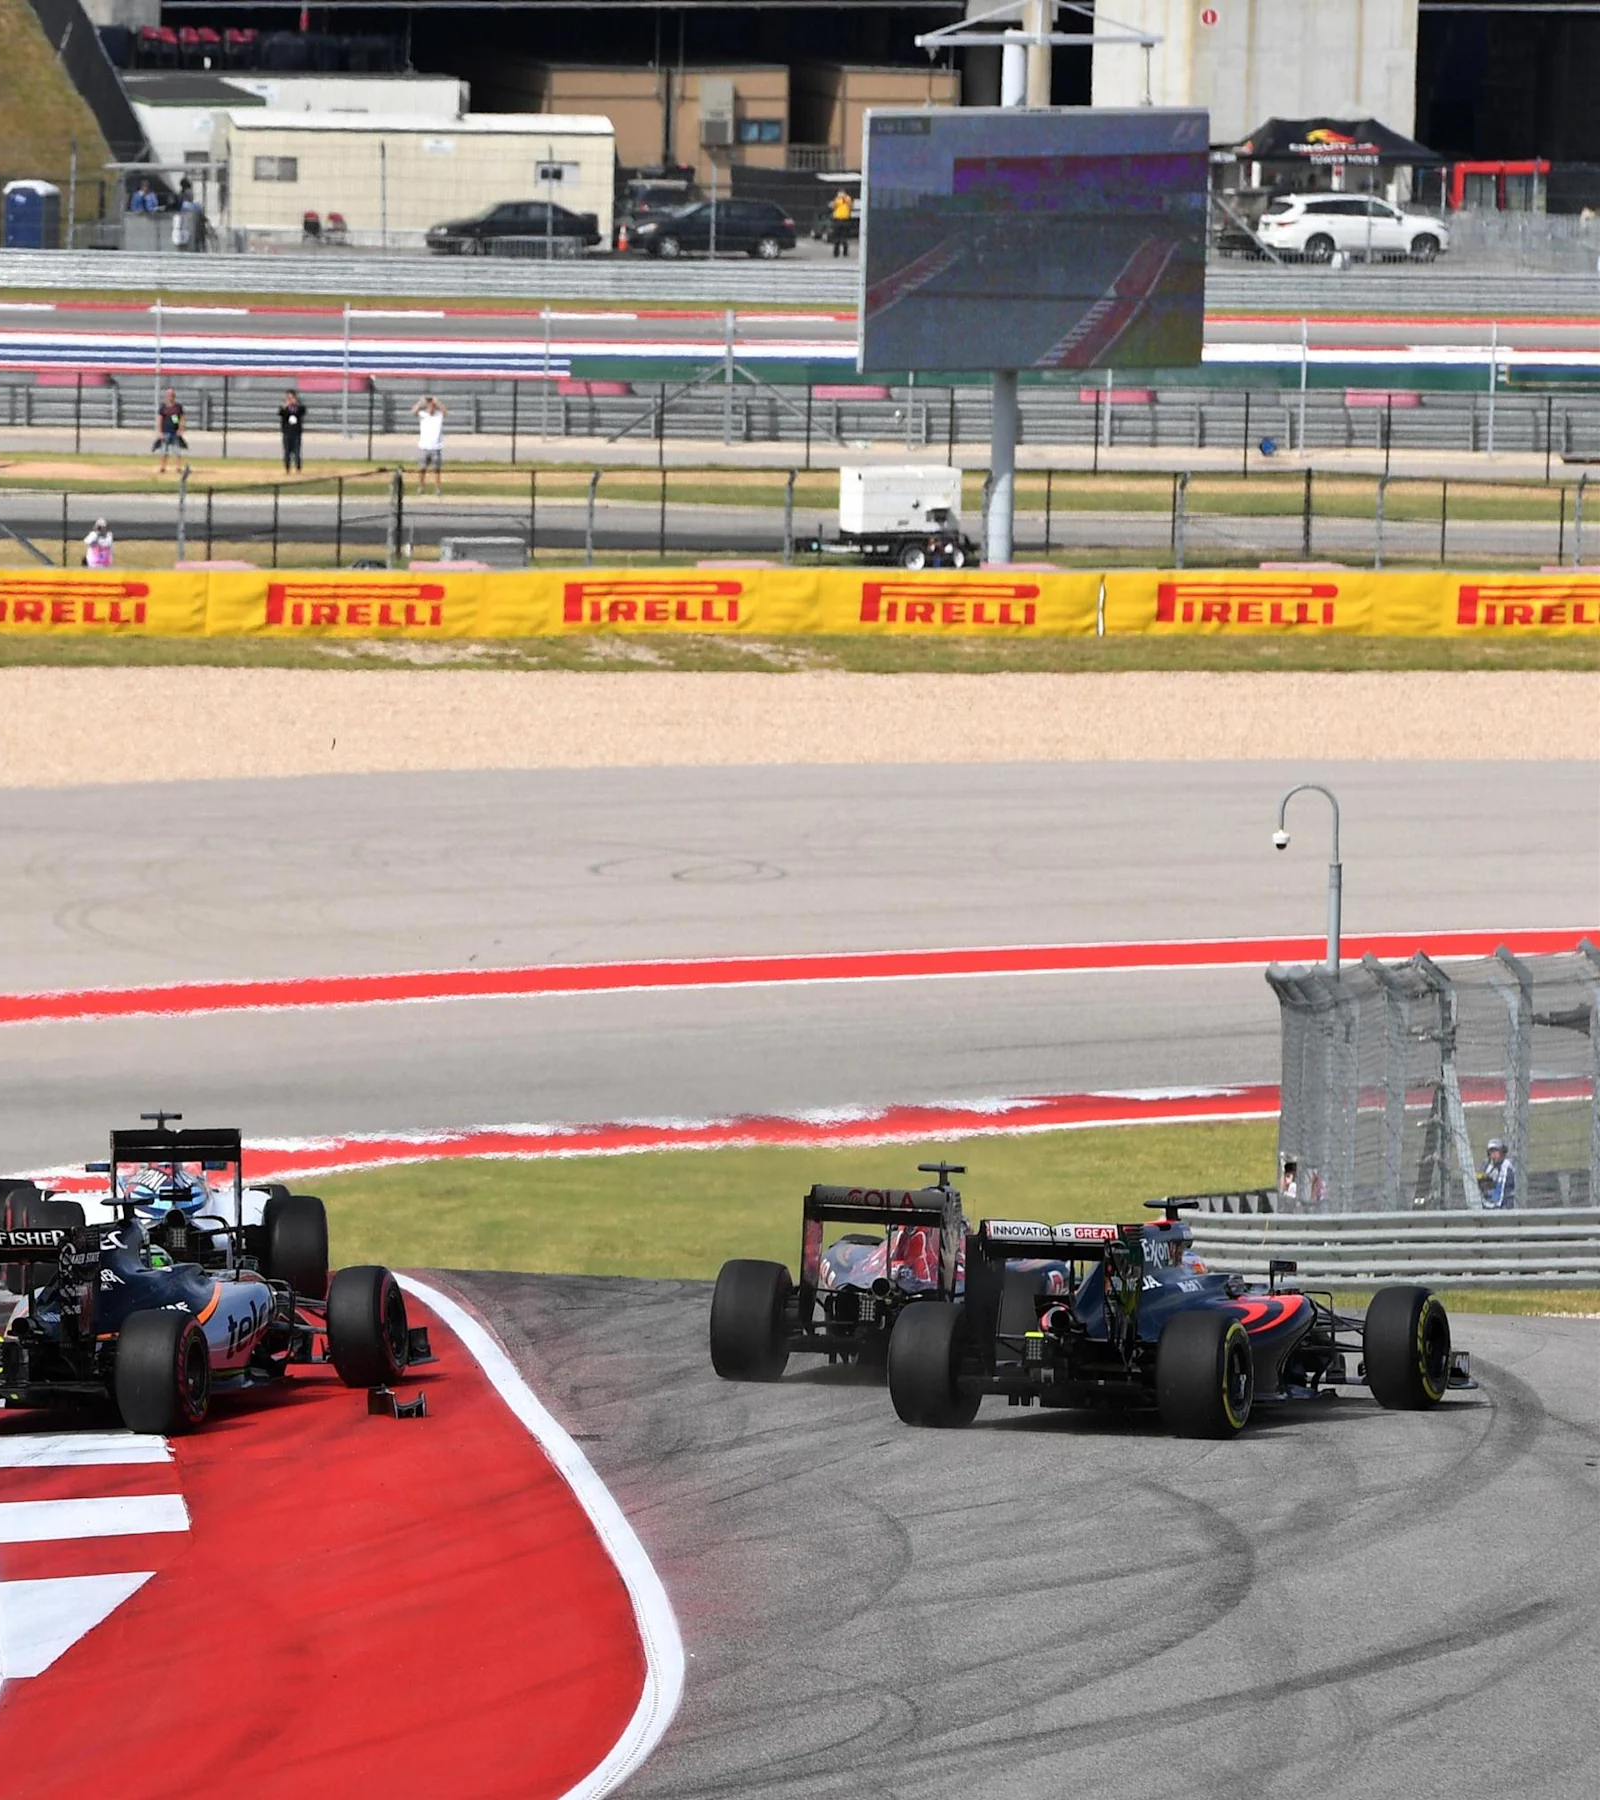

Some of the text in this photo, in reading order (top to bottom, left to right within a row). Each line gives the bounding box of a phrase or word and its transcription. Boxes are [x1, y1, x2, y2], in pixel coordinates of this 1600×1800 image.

[265, 583, 445, 626] PIRELLI
[563, 581, 743, 623] PIRELLI
[860, 582, 1041, 626] PIRELLI
[1155, 583, 1338, 625] PIRELLI
[1457, 585, 1600, 625] PIREL
[847, 1189, 916, 1209] COLA
[993, 1225, 1056, 1237] INNOVATION
[1061, 1228, 1071, 1237] IS
[1076, 1228, 1114, 1239] GREAT
